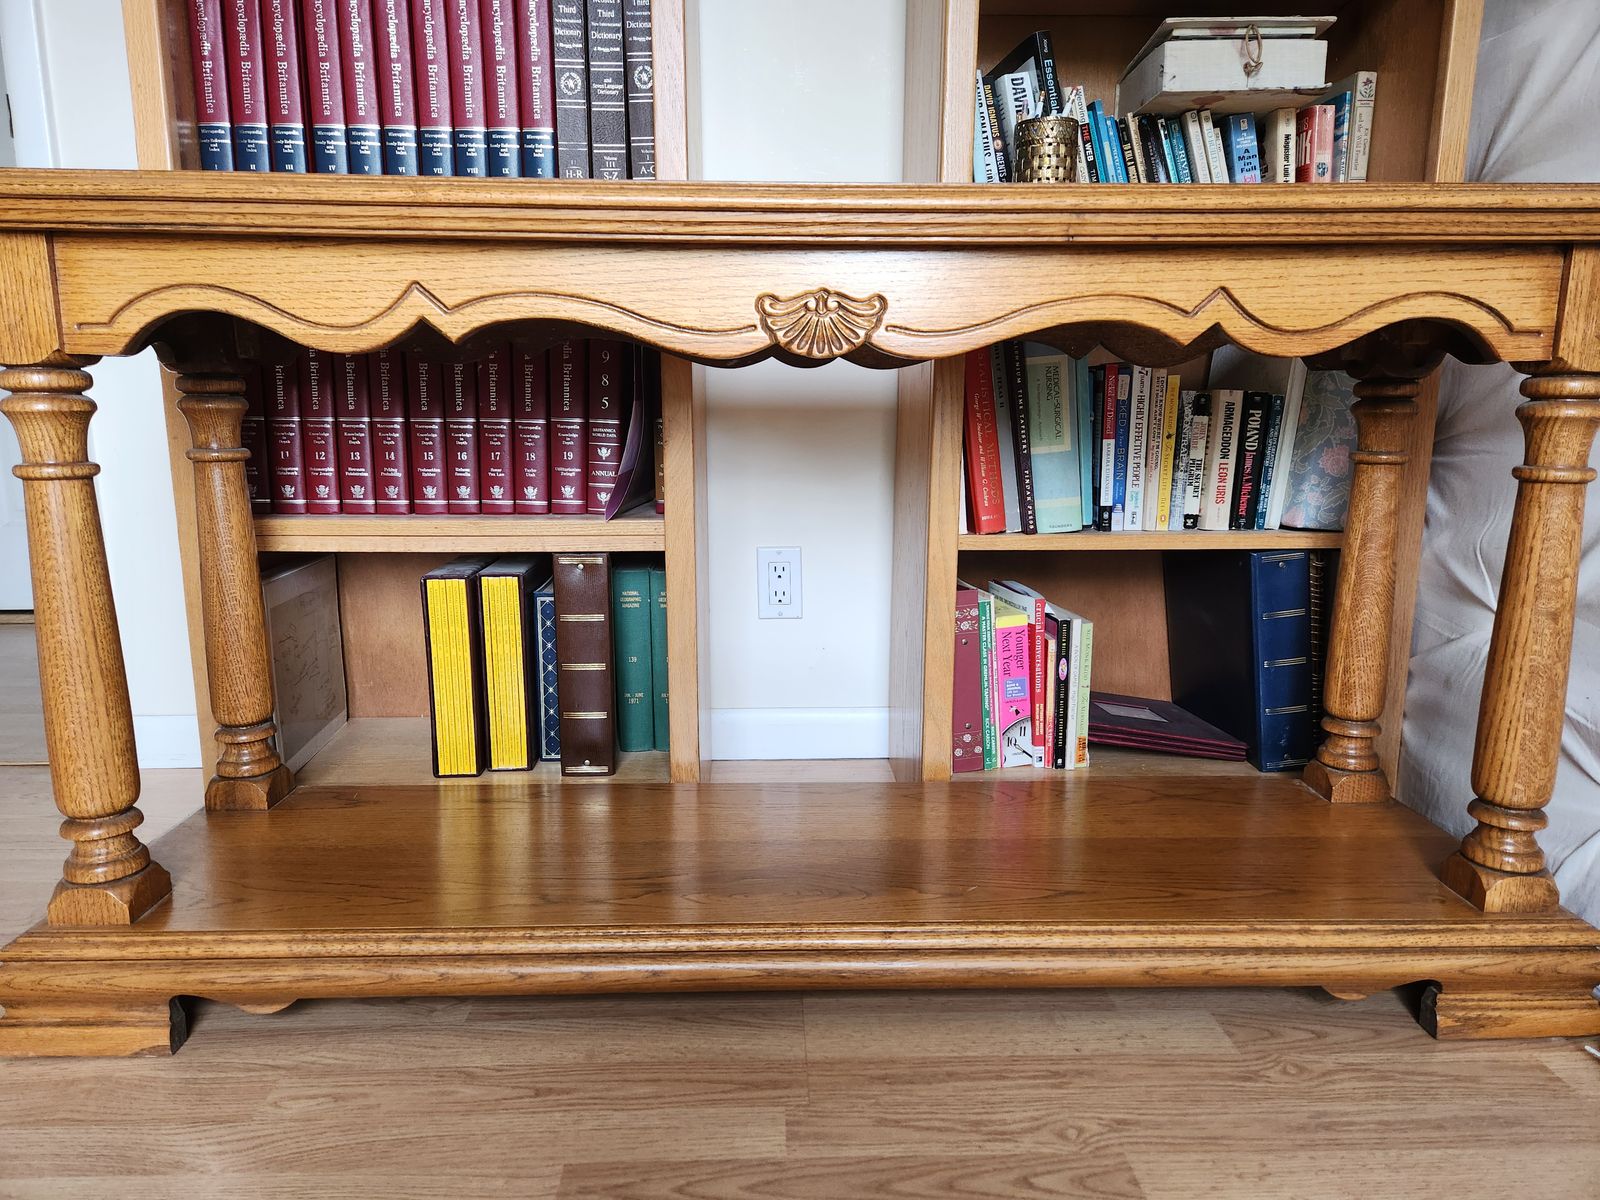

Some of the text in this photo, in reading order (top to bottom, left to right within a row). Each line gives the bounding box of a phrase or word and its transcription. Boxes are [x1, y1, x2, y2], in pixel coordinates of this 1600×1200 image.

[558, 5, 576, 14] Third
[597, 10, 615, 18] Third
[554, 28, 582, 37] Dictionary
[592, 31, 622, 40] Dictionary
[202, 61, 215, 113] Britannica
[242, 62, 254, 114] Britannica
[277, 62, 290, 114] Britannica
[320, 62, 332, 116] Britannica
[354, 62, 368, 116] Britannica
[392, 63, 404, 117] Britannica
[428, 65, 440, 118] Britannica
[464, 66, 475, 118] Britannica
[496, 66, 508, 118] Britannica
[532, 66, 542, 119] Britannica
[1044, 59, 1059, 110] Essential
[984, 84, 1006, 177] DAVID IGNATIUS AGENTS
[1076, 88, 1086, 123] Weaving
[1085, 142, 1094, 162] WEB
[1179, 150, 1192, 183] RIVER
[1283, 134, 1292, 163] Magister
[309, 362, 320, 410] Britannica
[345, 362, 355, 410] Britannica
[381, 362, 390, 411] Britannica
[419, 362, 428, 411] Britannica
[454, 363, 464, 412] Britannica
[488, 363, 497, 411] Britannica
[525, 364, 534, 412] Britannica
[562, 362, 572, 411] Britannica
[601, 350, 609, 409] 9 8 5
[1052, 366, 1062, 440] MEDICAL-SURGICAL
[1135, 394, 1145, 421] HIGHLY
[978, 354, 1000, 505] STATISTICAL METHODS
[1133, 422, 1143, 460] EFFECTIVE
[1245, 410, 1262, 450] POLAND
[281, 451, 289, 459] 11
[315, 451, 325, 460] 12
[350, 452, 360, 460] 13
[385, 451, 395, 460] 14
[424, 452, 434, 460] 15
[457, 452, 467, 460] 16
[490, 452, 500, 460] 17
[526, 452, 536, 460] 18
[563, 452, 573, 460] 19
[1116, 448, 1124, 480] BRAIN
[1187, 458, 1196, 486] PILGRIM
[1215, 401, 1236, 504] ARMAGEDDON LEON URIS
[1244, 452, 1256, 473] James
[1132, 462, 1141, 488] PEOPLE
[1193, 473, 1201, 499] SECRET
[1238, 482, 1252, 516] Michener
[1002, 632, 1012, 677] Next Year
[1014, 629, 1025, 670] Younger
[1035, 603, 1045, 693] crucial conversations
[1007, 737, 1017, 747] 10
[1020, 726, 1026, 736] 11
